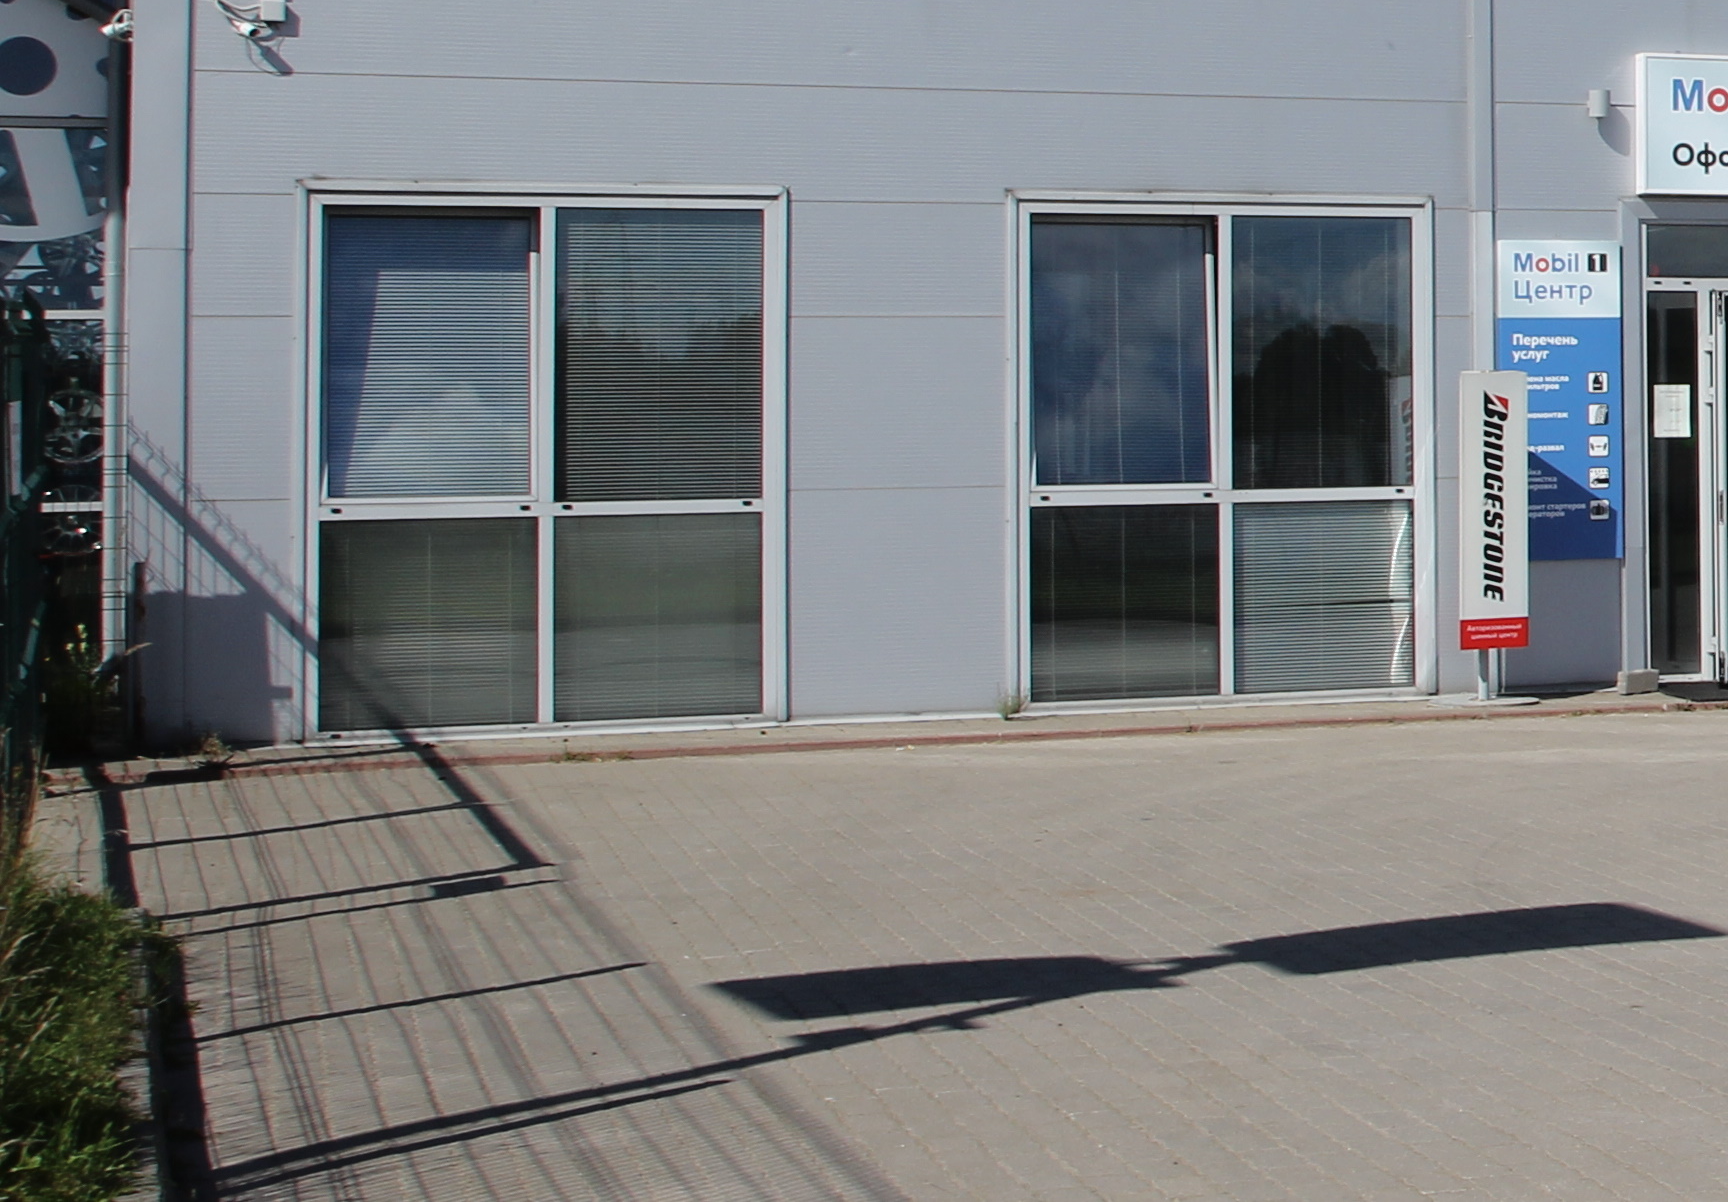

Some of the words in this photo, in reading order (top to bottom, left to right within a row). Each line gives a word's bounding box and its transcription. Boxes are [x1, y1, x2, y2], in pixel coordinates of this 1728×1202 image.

[1513, 253, 1580, 273] Mobil
[1514, 280, 1594, 305] Центр
[1512, 334, 1578, 349] Перечень
[1512, 350, 1550, 363] услуг
[1483, 390, 1509, 602] BRIDGESTONE
